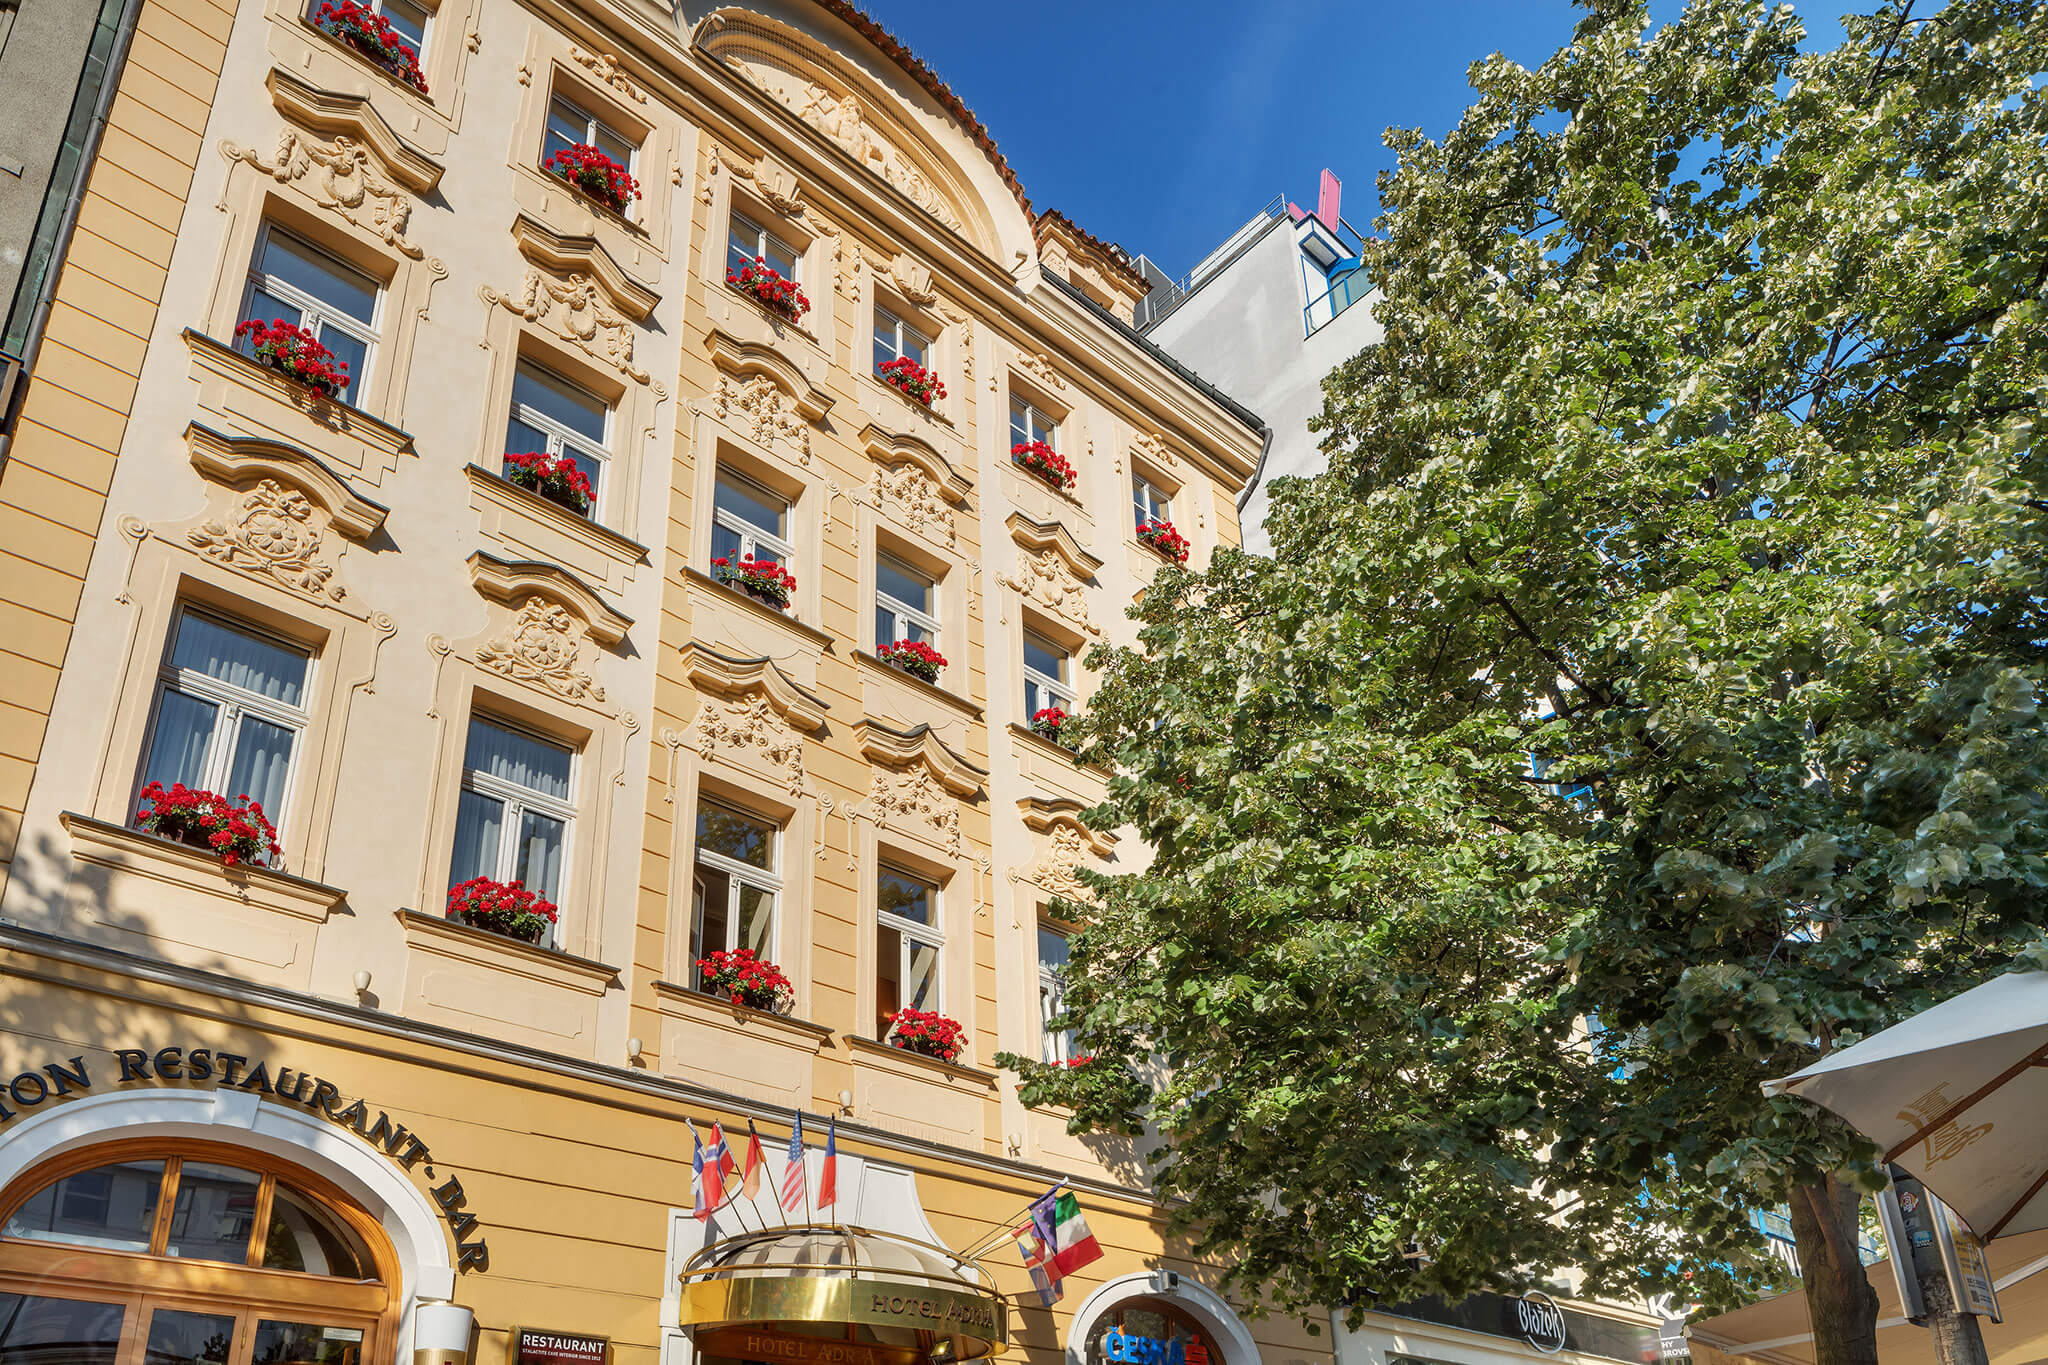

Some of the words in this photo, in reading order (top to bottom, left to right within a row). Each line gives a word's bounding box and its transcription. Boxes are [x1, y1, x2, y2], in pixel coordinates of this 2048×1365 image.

[113, 1047, 431, 1173] RESTAURANT
[429, 1174, 488, 1276] BAR
[871, 1294, 942, 1319] HOTEL
[944, 1297, 994, 1329] ADRIA
[1518, 1299, 1563, 1341] Blažek
[523, 1335, 604, 1353] RESTAURANT
[746, 1336, 807, 1358] HOTEL
[816, 1343, 875, 1365] ADRA
[1663, 1348, 1690, 1357] BROVS
